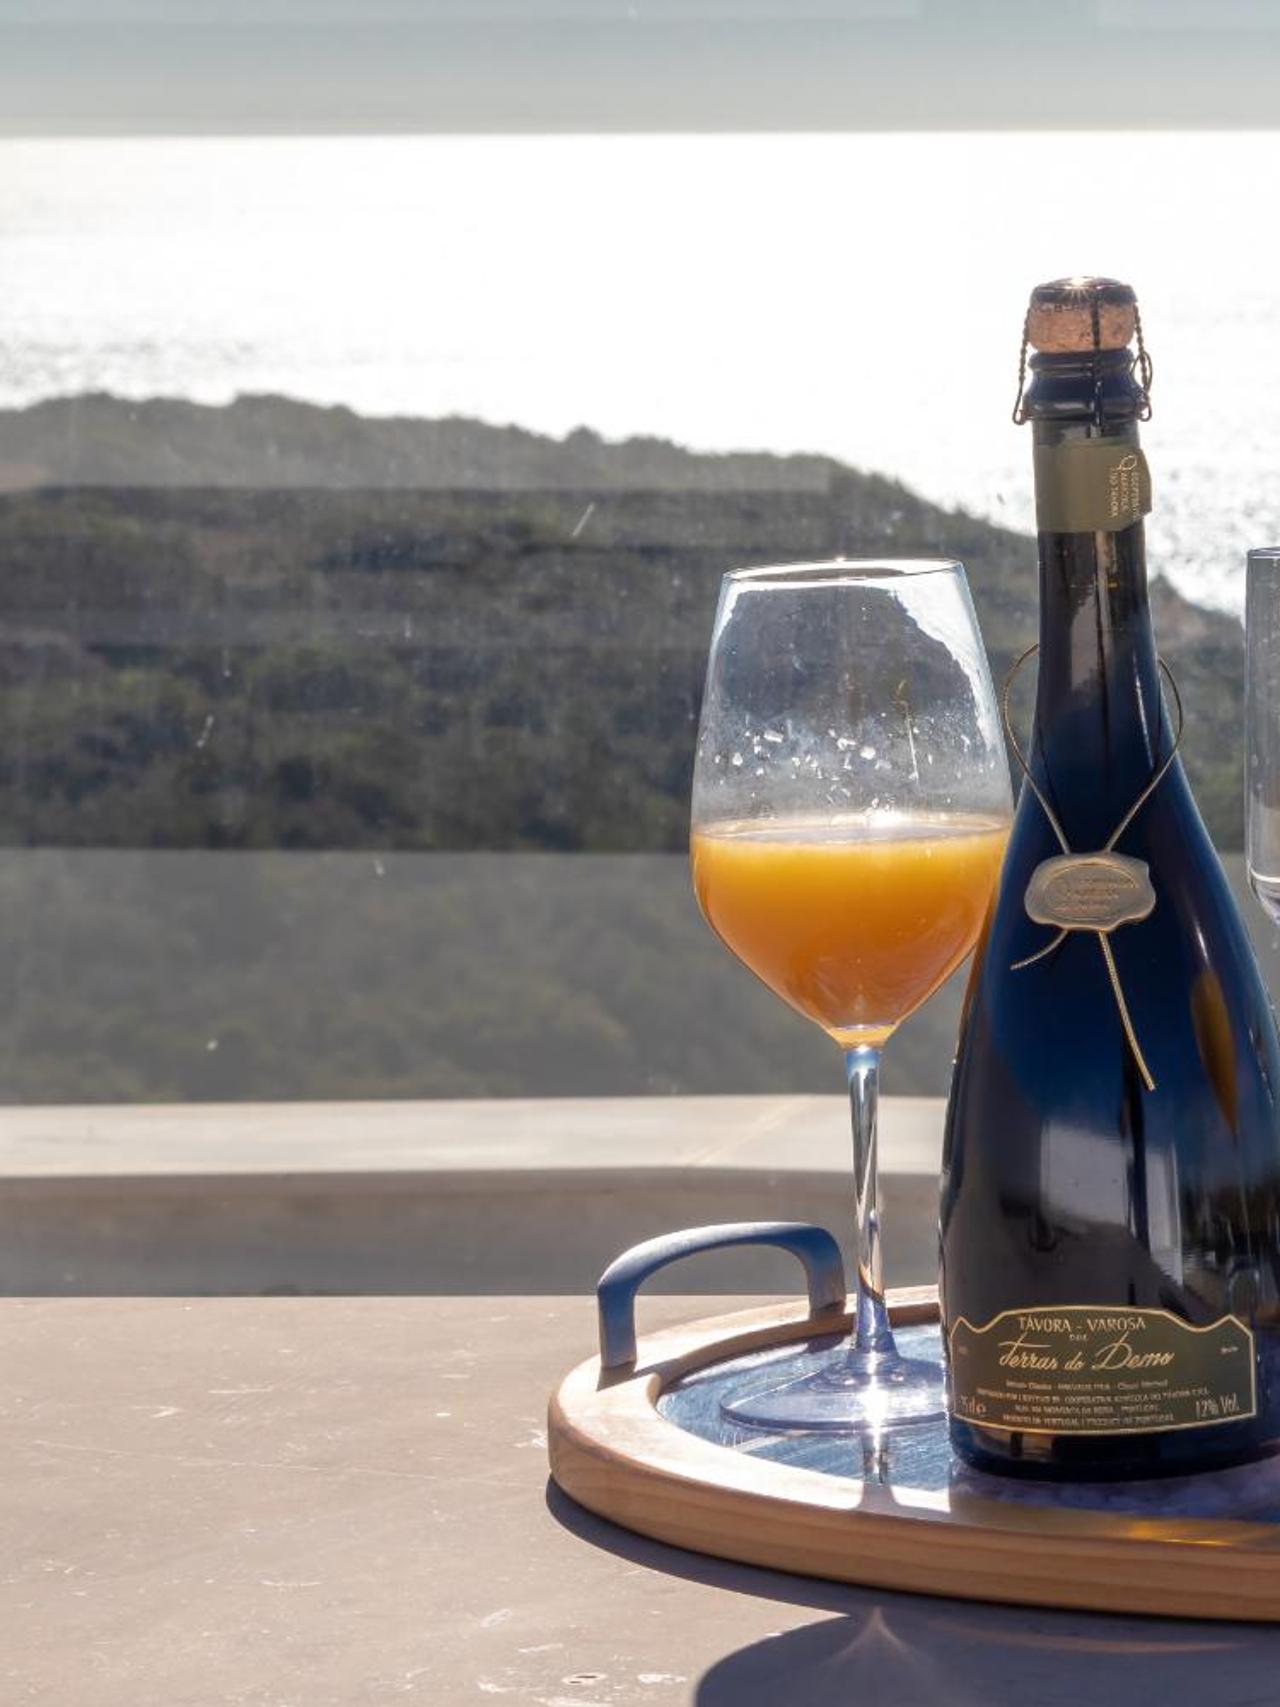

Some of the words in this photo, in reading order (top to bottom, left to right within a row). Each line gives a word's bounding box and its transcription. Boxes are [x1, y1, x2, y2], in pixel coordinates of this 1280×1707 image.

[1018, 1315, 1071, 1332] TÁVORA
[1086, 1316, 1146, 1332] VAROSA
[998, 1332, 1058, 1370] Terras
[1092, 1331, 1175, 1370] Demo
[1195, 1399, 1219, 1419] 12%
